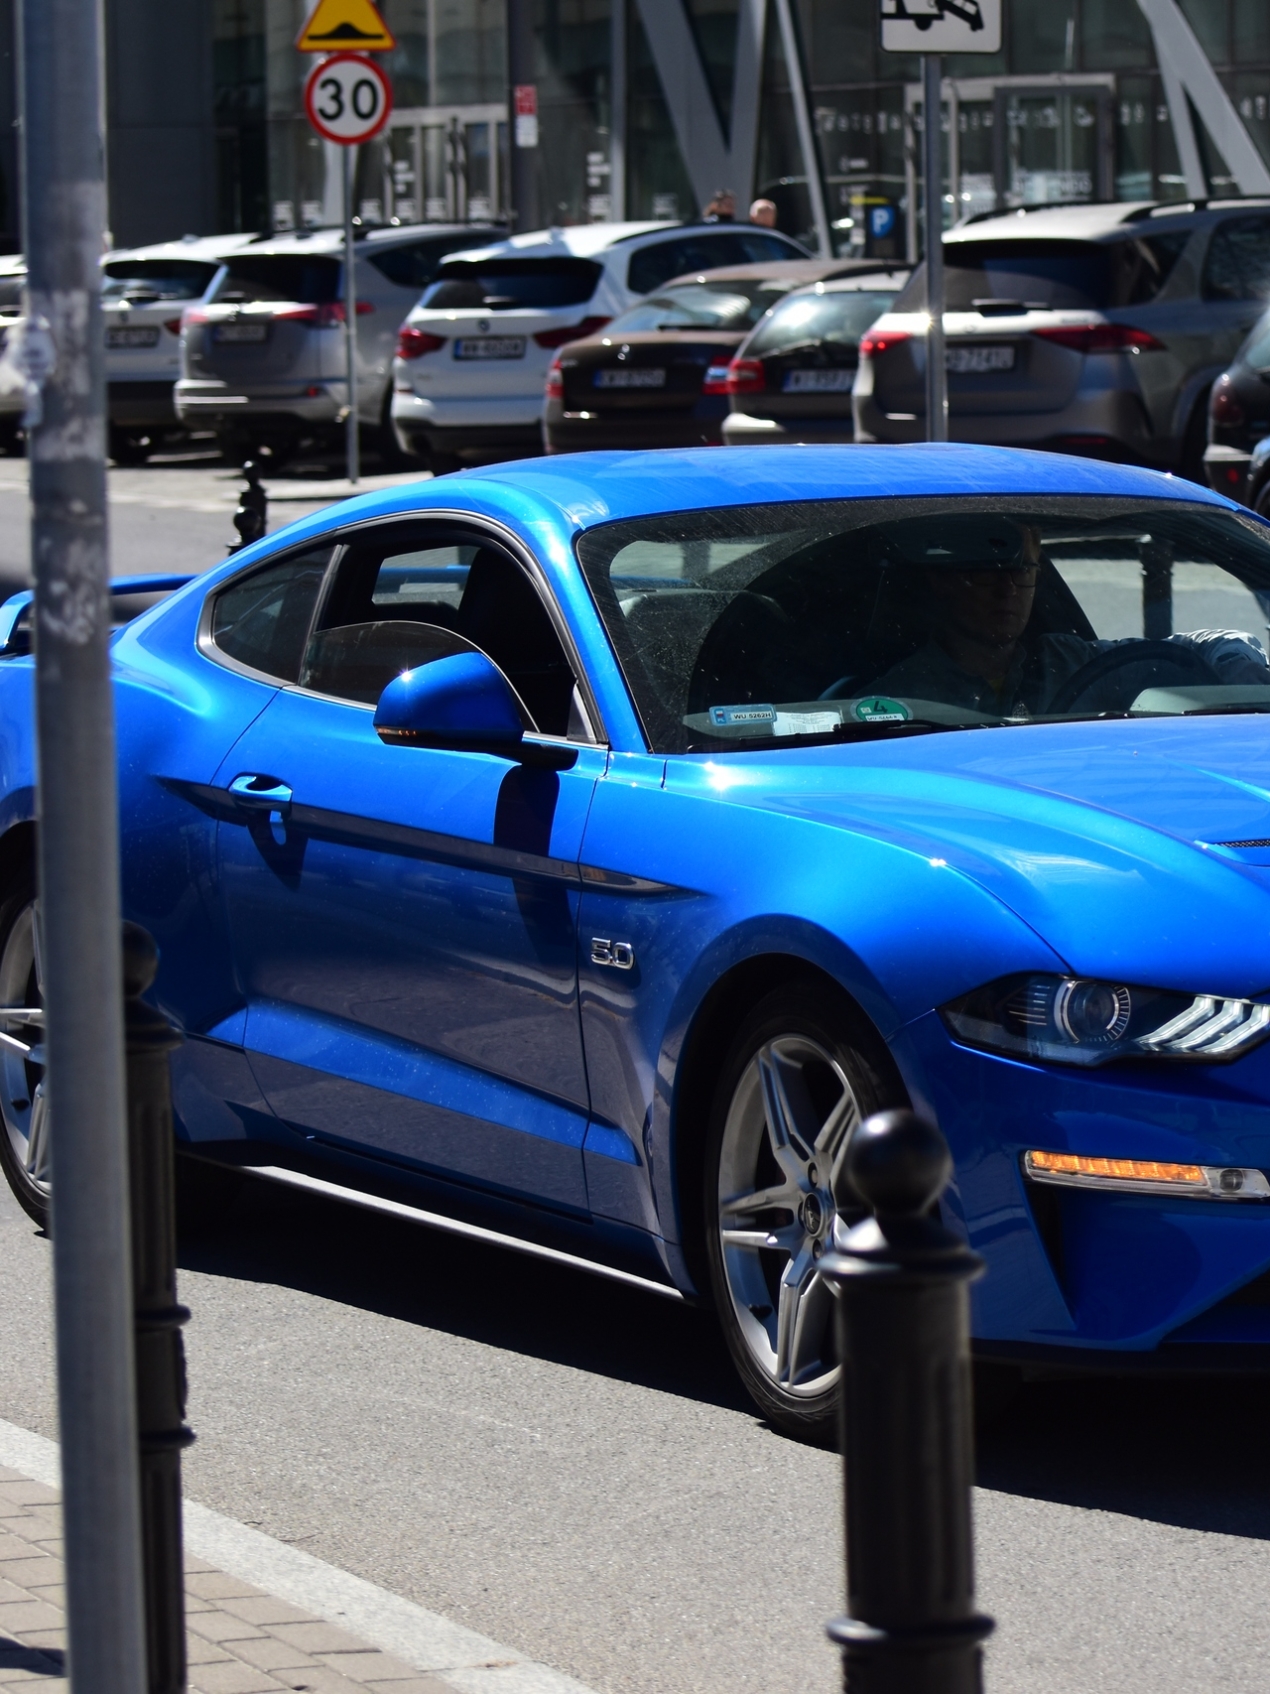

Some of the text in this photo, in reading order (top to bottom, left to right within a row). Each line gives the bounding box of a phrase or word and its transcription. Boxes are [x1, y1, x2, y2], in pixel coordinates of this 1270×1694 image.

[317, 78, 379, 121] 30
[872, 208, 889, 235] P
[873, 700, 888, 714] 4
